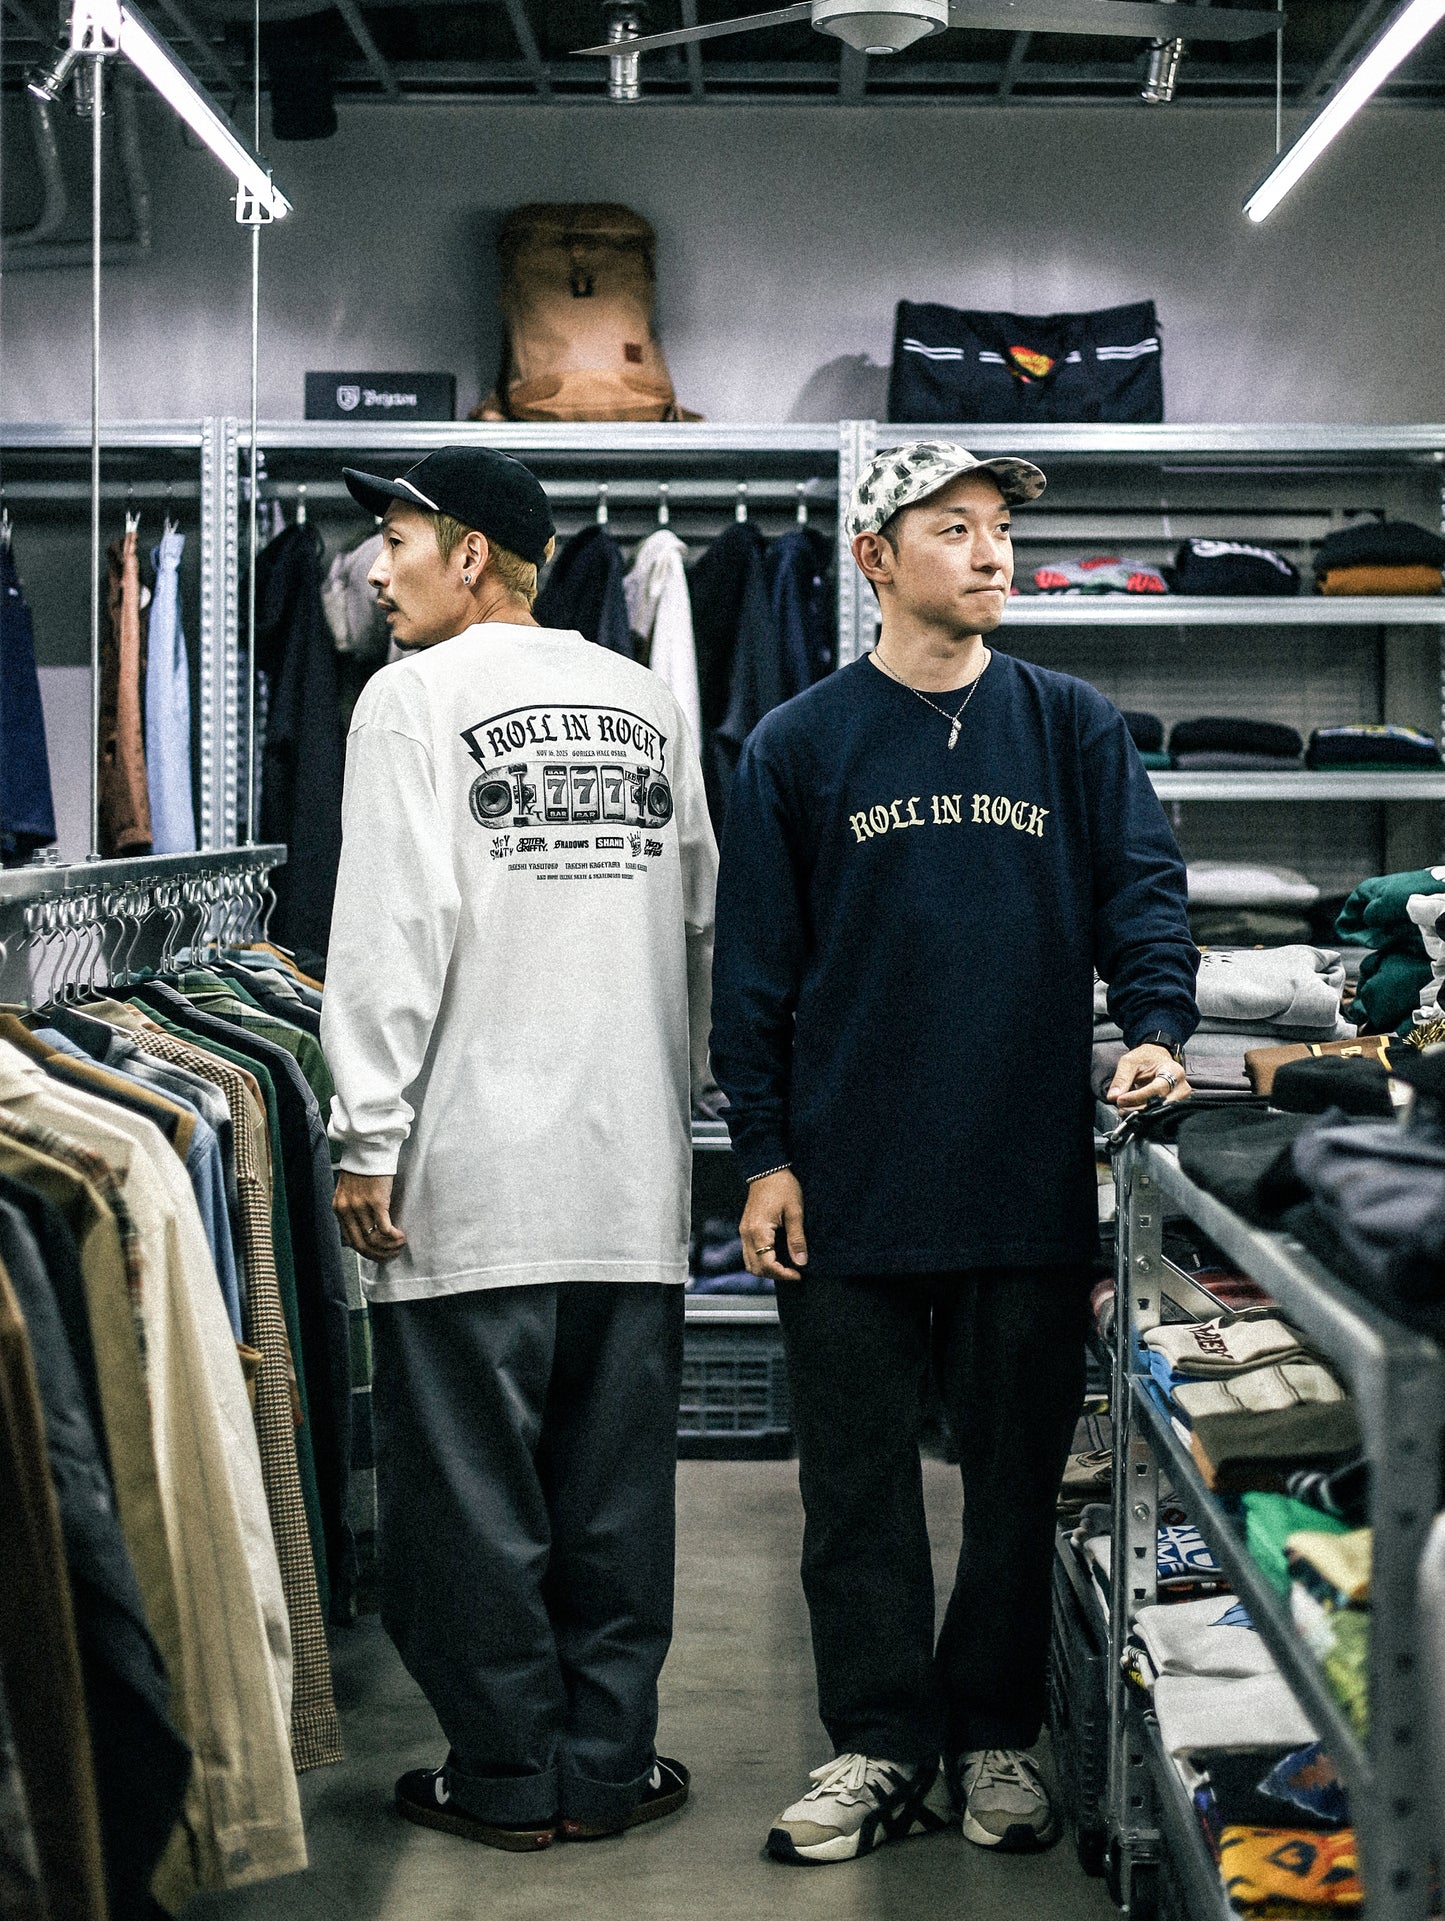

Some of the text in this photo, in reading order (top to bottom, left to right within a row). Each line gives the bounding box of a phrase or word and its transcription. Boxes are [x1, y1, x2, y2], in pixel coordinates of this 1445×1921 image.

[486, 713, 657, 761] ROLL IN ROCK
[547, 779, 566, 805] 7
[573, 778, 596, 804] 7
[605, 778, 623, 803] 7
[849, 793, 1050, 844] ROLL IN ROCK
